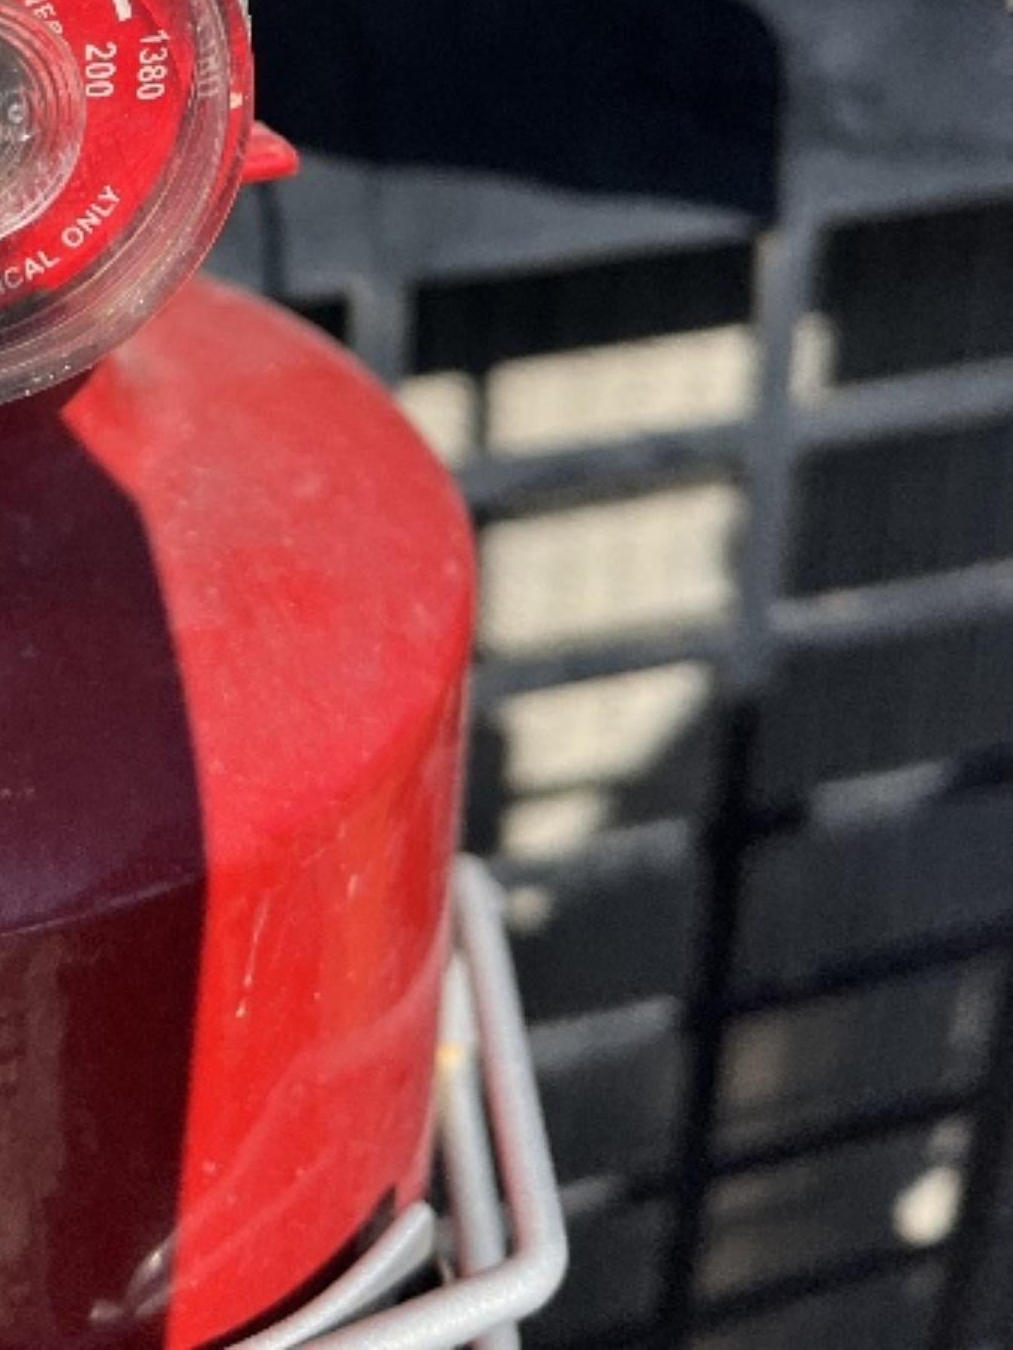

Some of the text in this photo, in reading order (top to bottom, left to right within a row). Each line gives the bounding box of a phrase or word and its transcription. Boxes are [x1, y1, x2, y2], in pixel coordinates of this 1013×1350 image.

[85, 41, 117, 98] 200
[136, 29, 171, 101] 1380
[61, 184, 121, 248] ONLY
